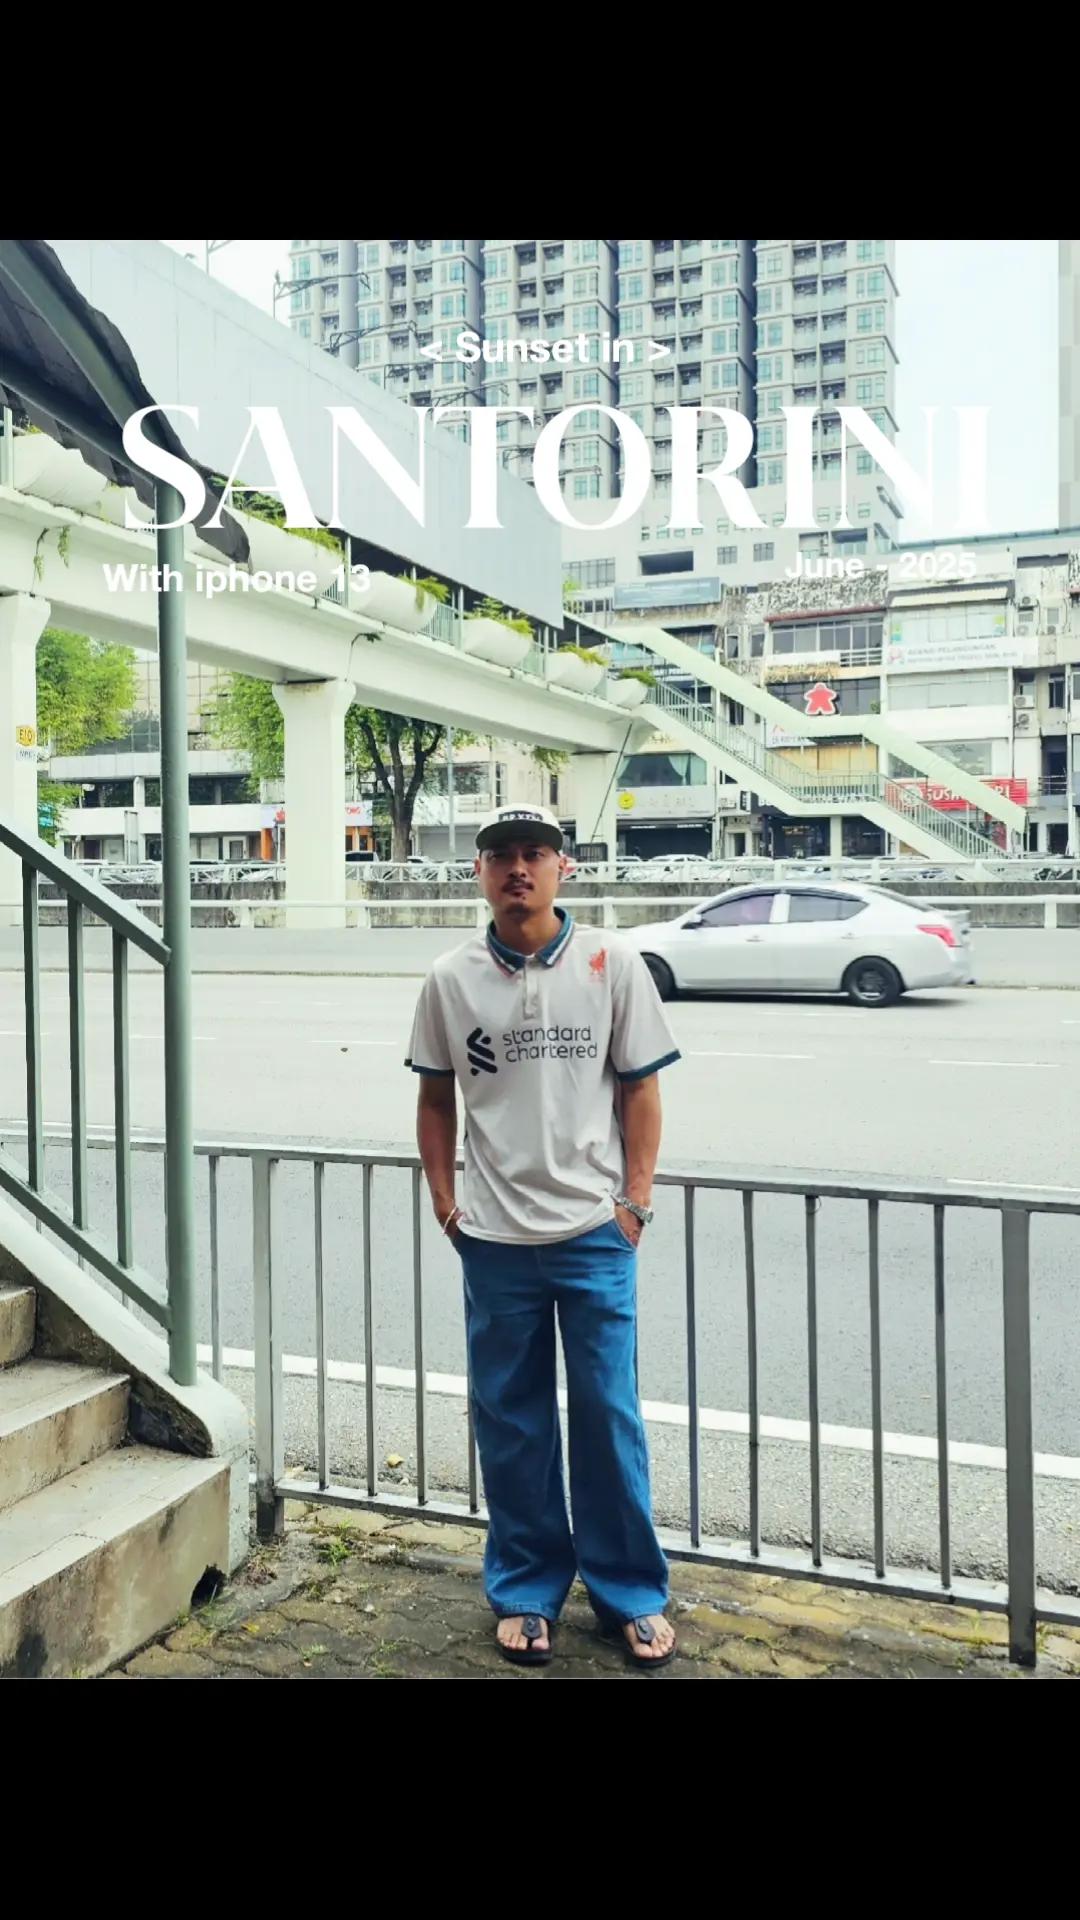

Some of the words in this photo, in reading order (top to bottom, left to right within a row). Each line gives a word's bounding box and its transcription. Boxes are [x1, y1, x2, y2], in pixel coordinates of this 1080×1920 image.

[926, 786, 963, 801] SUSH
[502, 1025, 592, 1047] standard
[505, 1043, 598, 1063] chartered
